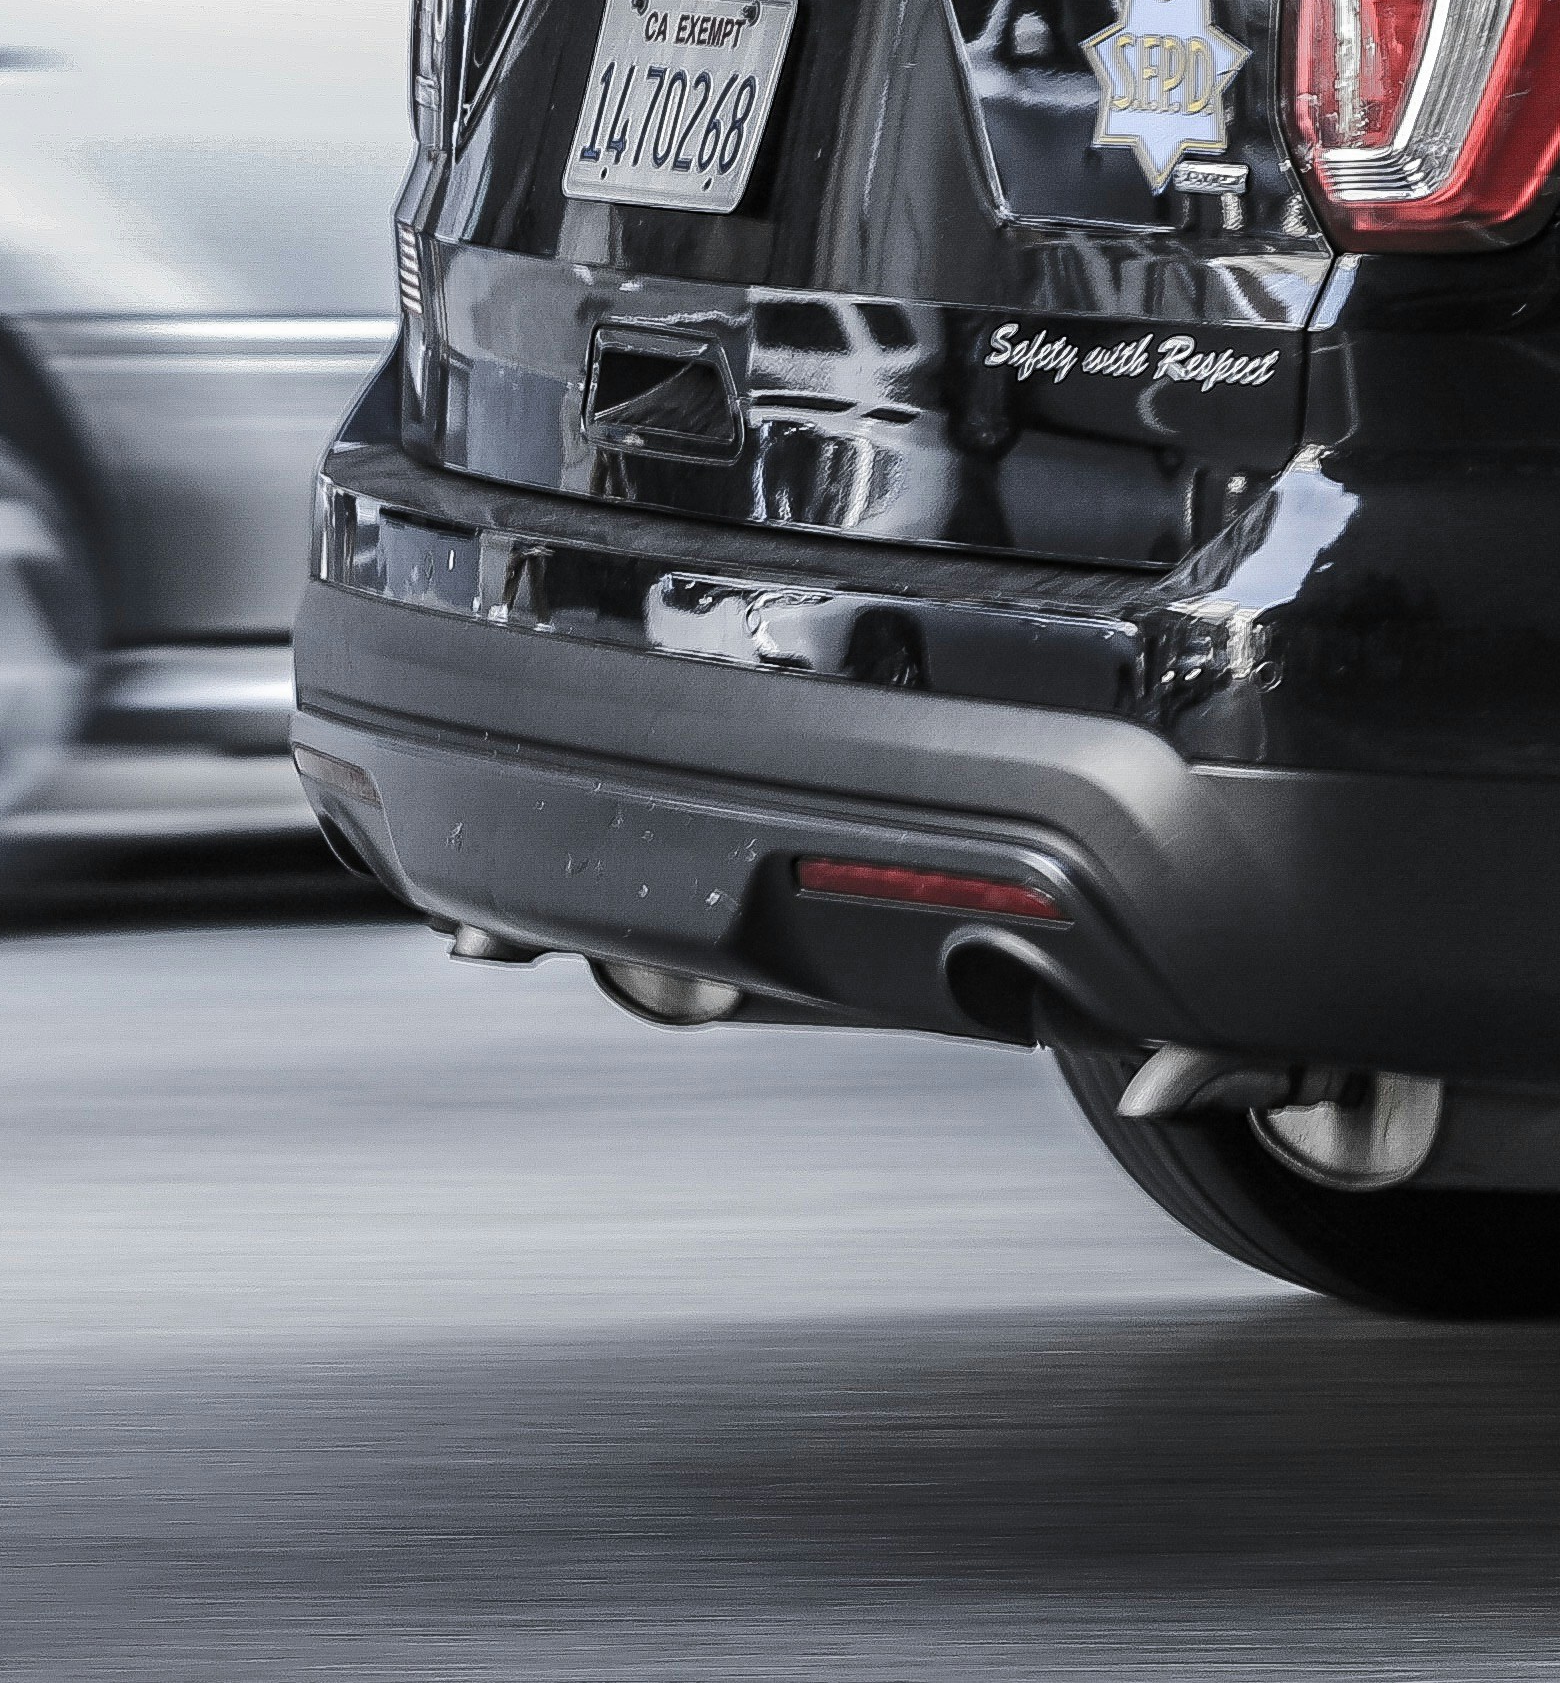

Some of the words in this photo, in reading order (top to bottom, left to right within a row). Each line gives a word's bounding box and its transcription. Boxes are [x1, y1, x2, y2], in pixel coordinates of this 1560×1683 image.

[645, 12, 669, 42] CA
[674, 15, 747, 48] EXEMPT
[580, 62, 757, 175] 1470268
[985, 323, 1079, 384] Safety
[1083, 333, 1154, 378] with
[1153, 335, 1280, 393] Respect
